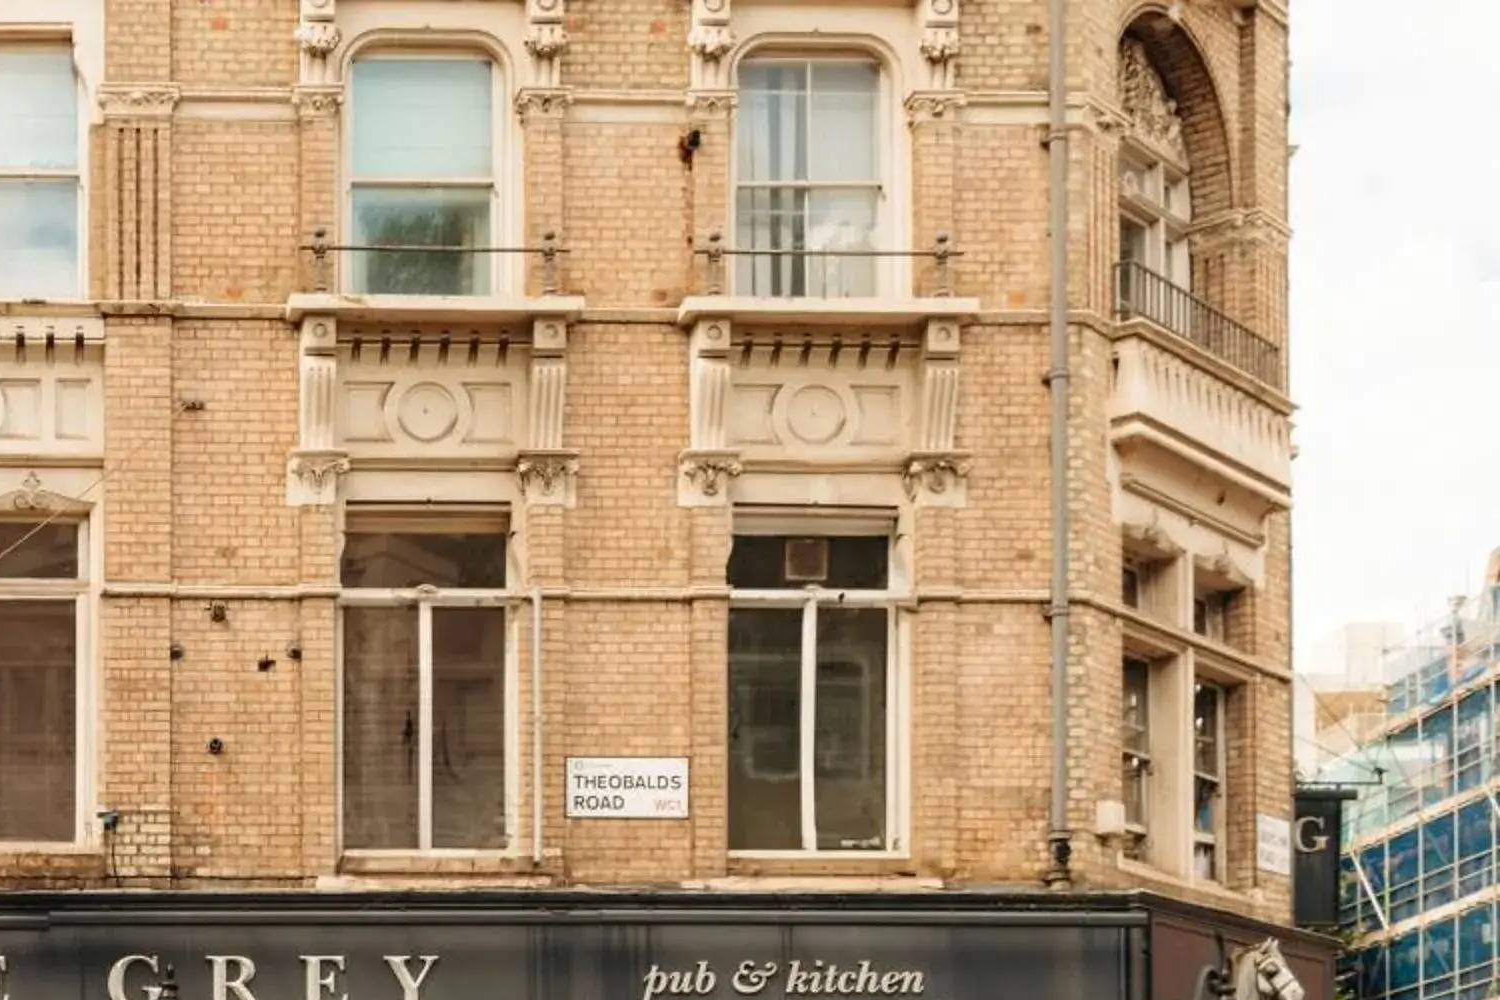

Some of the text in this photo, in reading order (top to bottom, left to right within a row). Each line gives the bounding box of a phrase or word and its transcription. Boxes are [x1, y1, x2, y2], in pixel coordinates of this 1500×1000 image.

[573, 775, 682, 790] THEOBALDS
[573, 795, 625, 811] ROAD
[1295, 815, 1330, 853] G
[731, 960, 778, 994] &
[785, 959, 925, 994] kitchen
